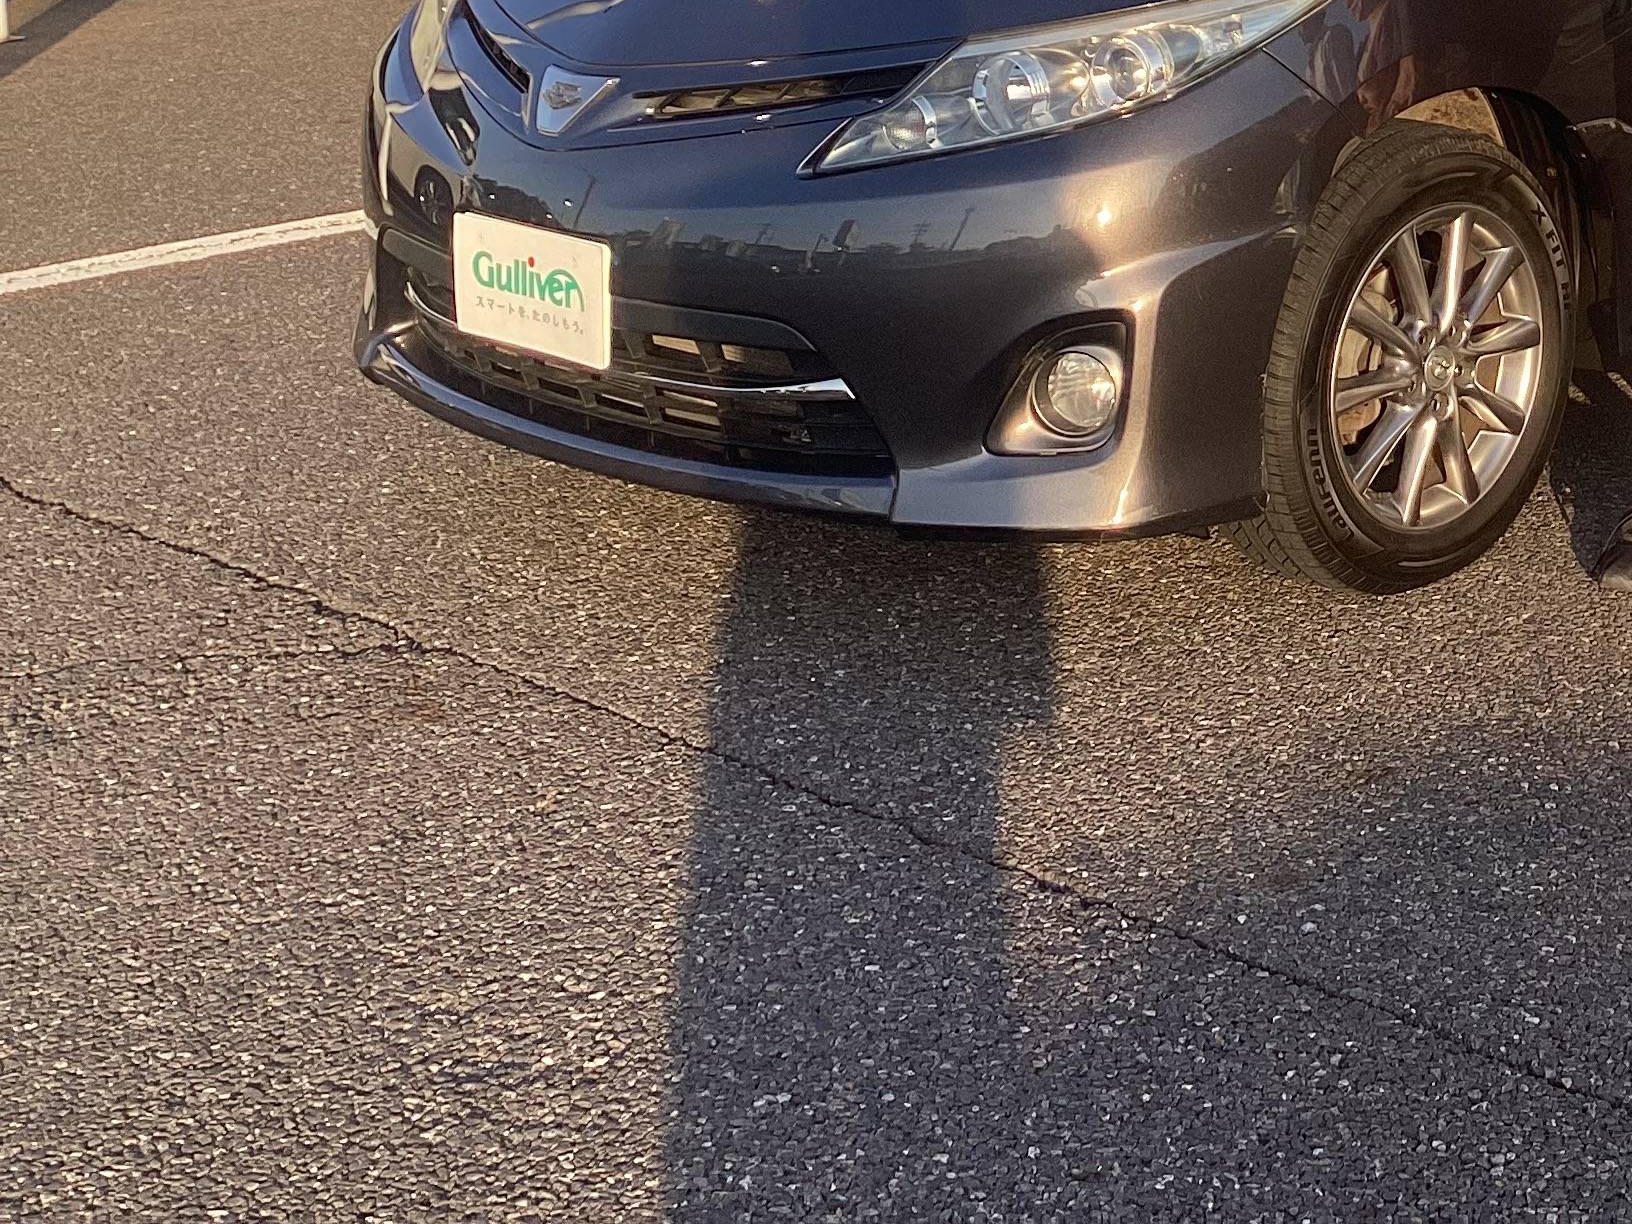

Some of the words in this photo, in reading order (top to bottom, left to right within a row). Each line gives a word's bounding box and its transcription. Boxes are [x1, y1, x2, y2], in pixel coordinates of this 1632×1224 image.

[472, 250, 585, 312] Gulliver
[475, 295, 585, 336] スマートを、たのしもう。
[1305, 427, 1356, 539] Laufenn
